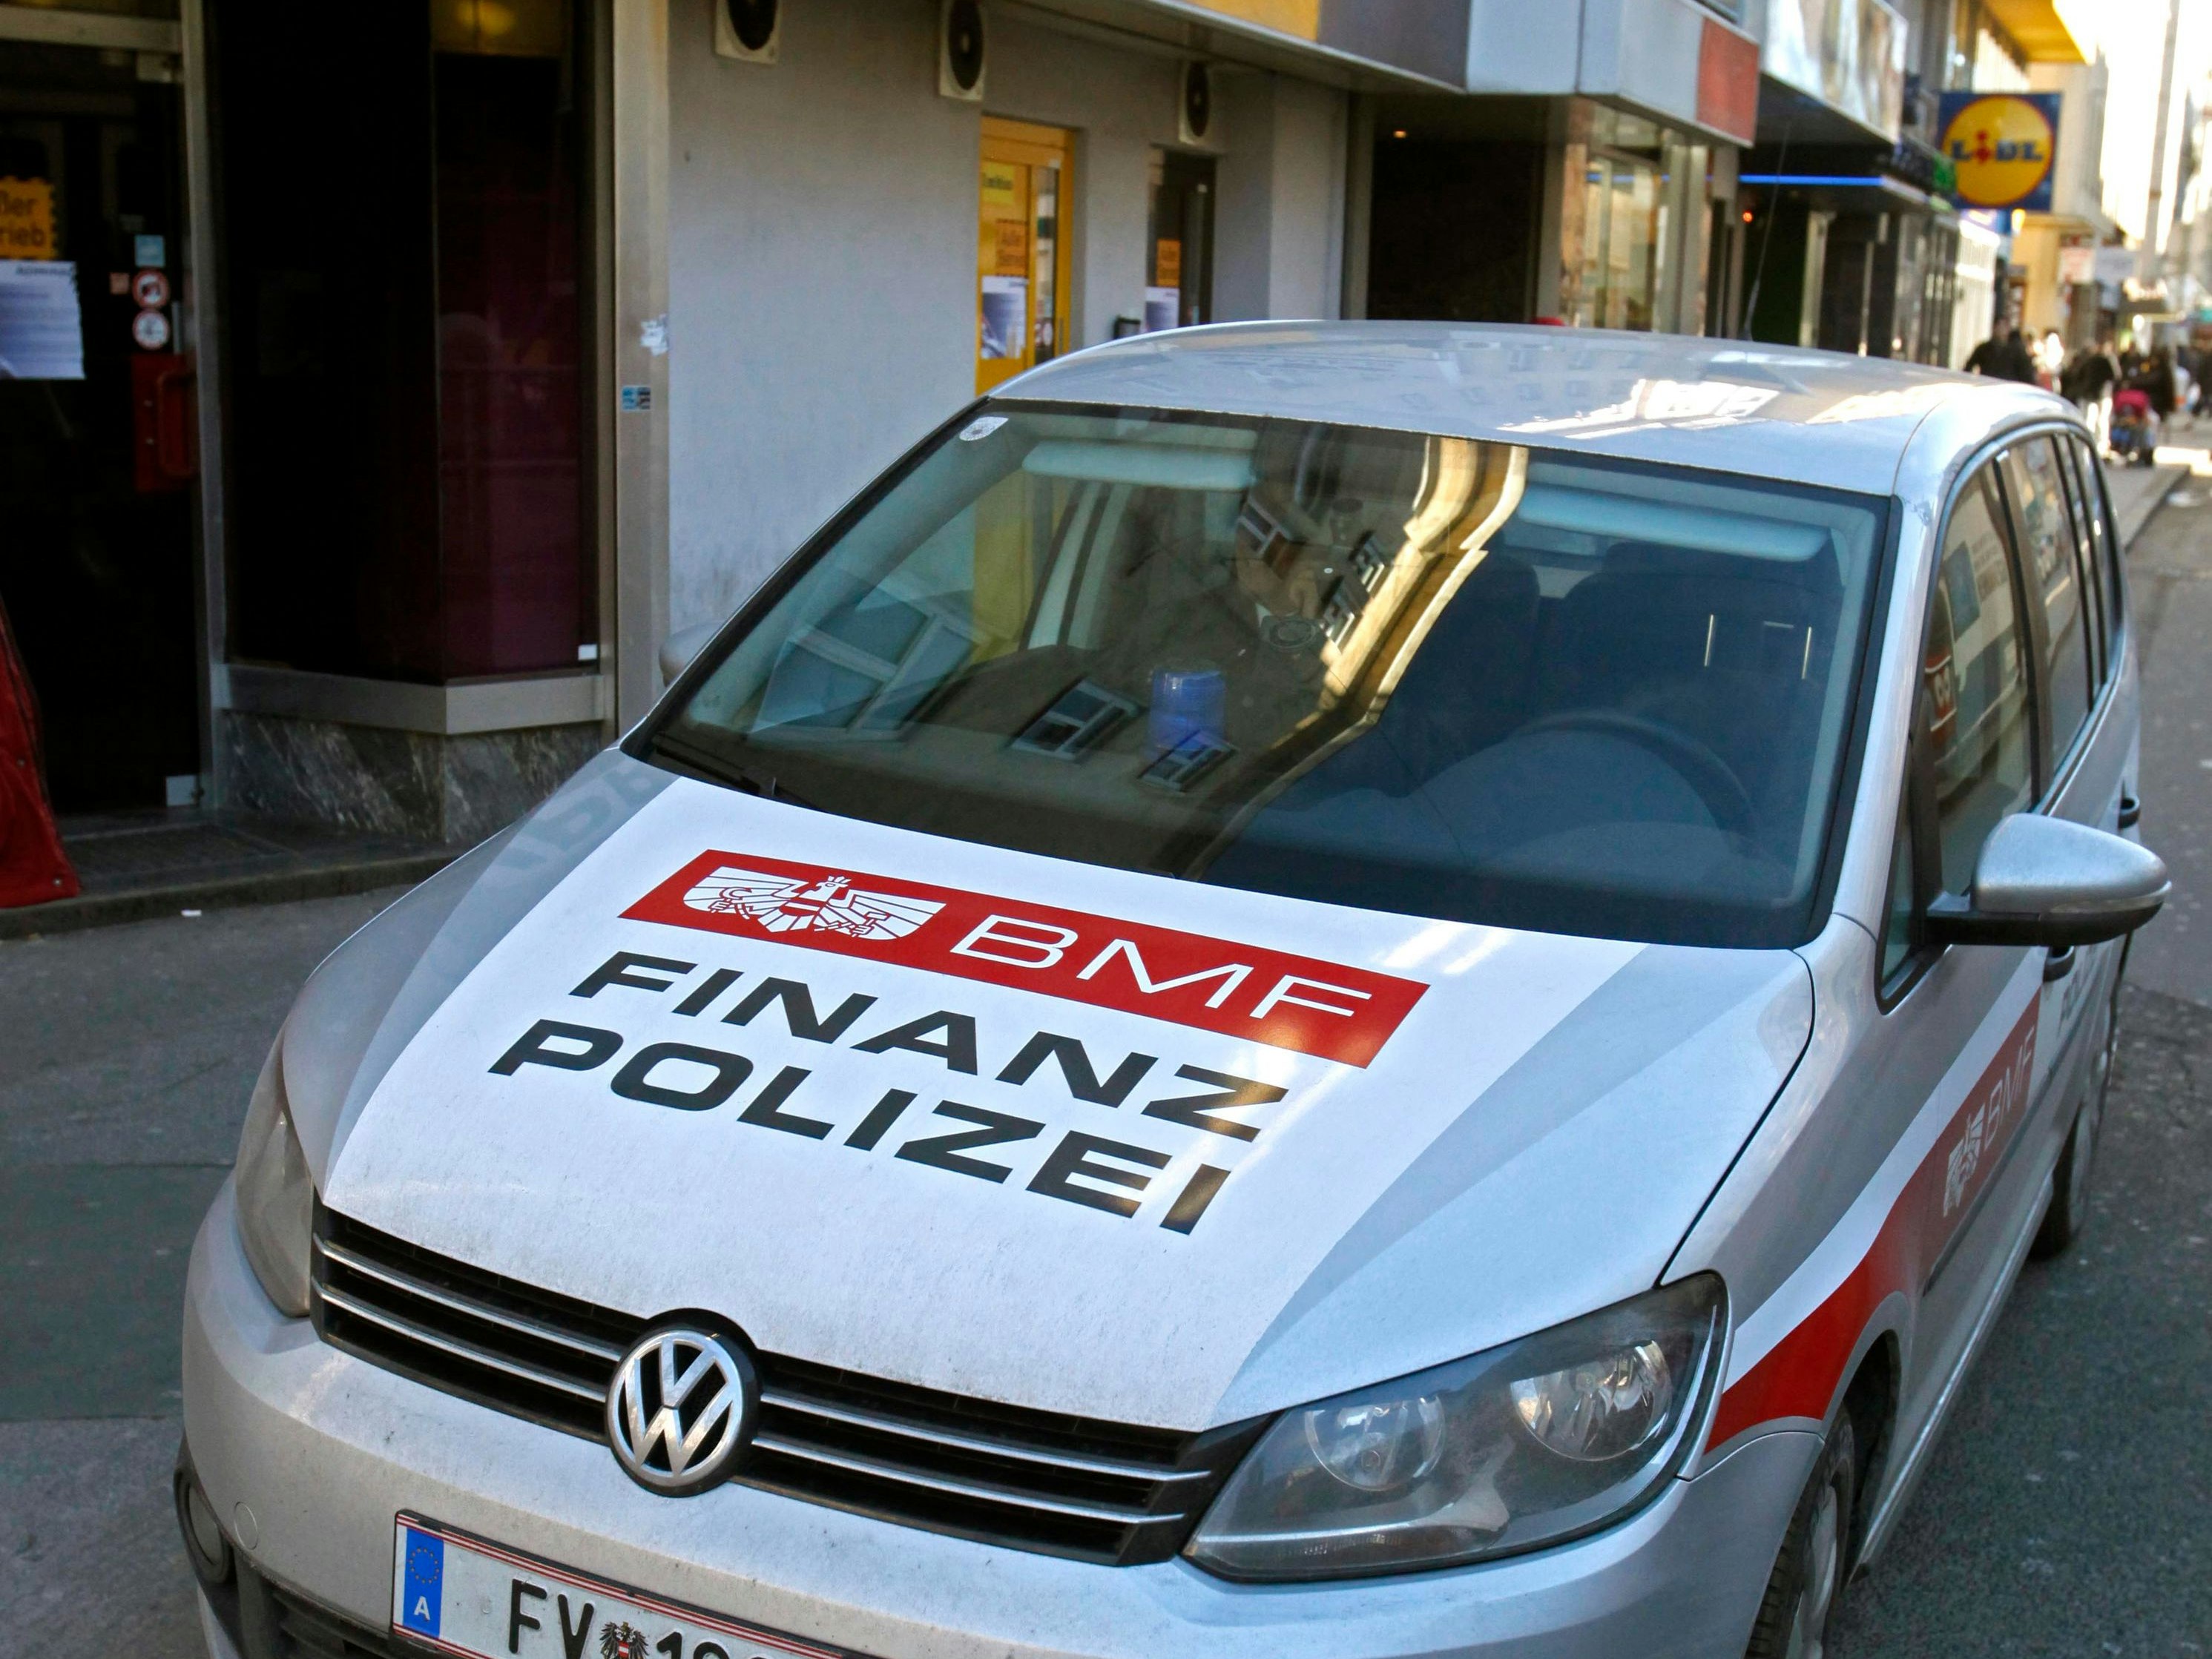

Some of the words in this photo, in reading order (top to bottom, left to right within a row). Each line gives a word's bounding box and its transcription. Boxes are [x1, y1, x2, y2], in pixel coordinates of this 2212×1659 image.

[949, 915, 1372, 1019] BMF
[569, 950, 1287, 1143] FINANZ
[487, 1018, 1231, 1236] POLIZEI
[414, 1596, 430, 1620] A
